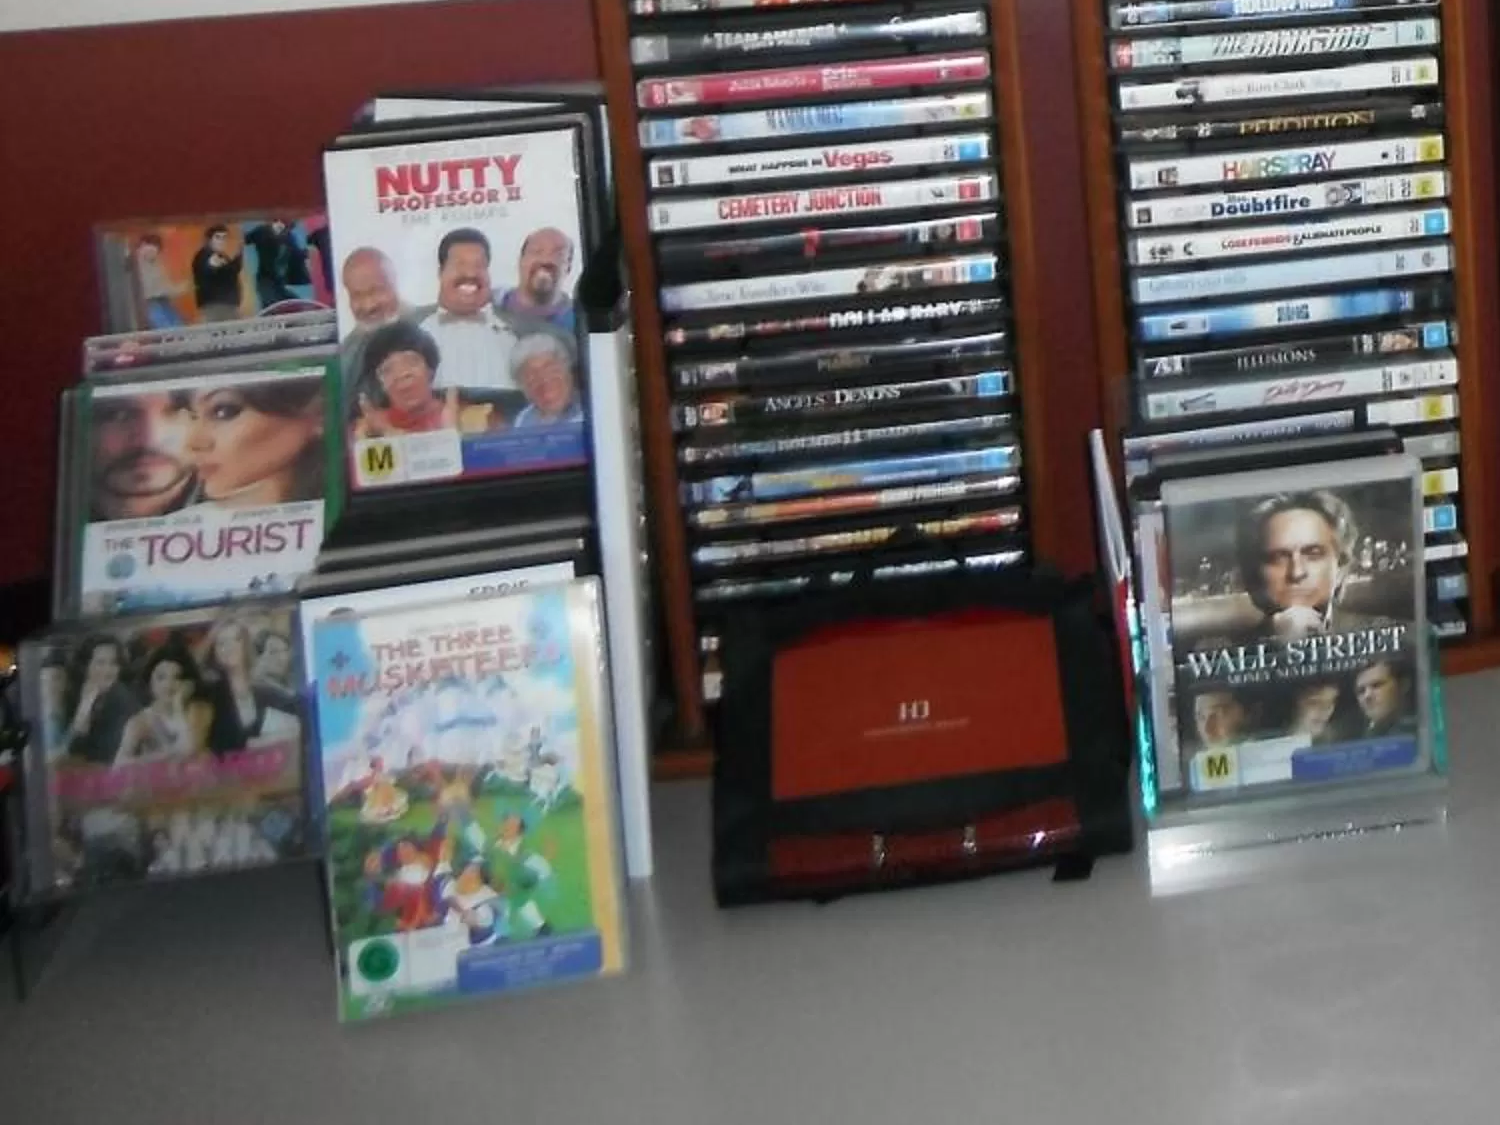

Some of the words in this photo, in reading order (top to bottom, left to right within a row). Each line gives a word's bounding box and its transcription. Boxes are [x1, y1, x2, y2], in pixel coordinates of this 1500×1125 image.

[822, 146, 895, 171] Vegas
[1222, 151, 1336, 180] HAIRSPRAY
[375, 154, 523, 198] NUTTY
[378, 188, 500, 214] PROFESSOR
[506, 185, 522, 202] II
[718, 193, 799, 220] CEMETERY
[804, 187, 882, 213] JUNCTION
[1211, 193, 1311, 217] Doubtfire
[367, 446, 394, 472] M
[105, 536, 134, 552] THE
[140, 518, 314, 566] TOURIST
[370, 639, 421, 662] THE
[430, 626, 515, 653] THREE
[1187, 646, 1279, 680] WALL
[1287, 625, 1406, 662] STREET
[1206, 754, 1229, 779] M
